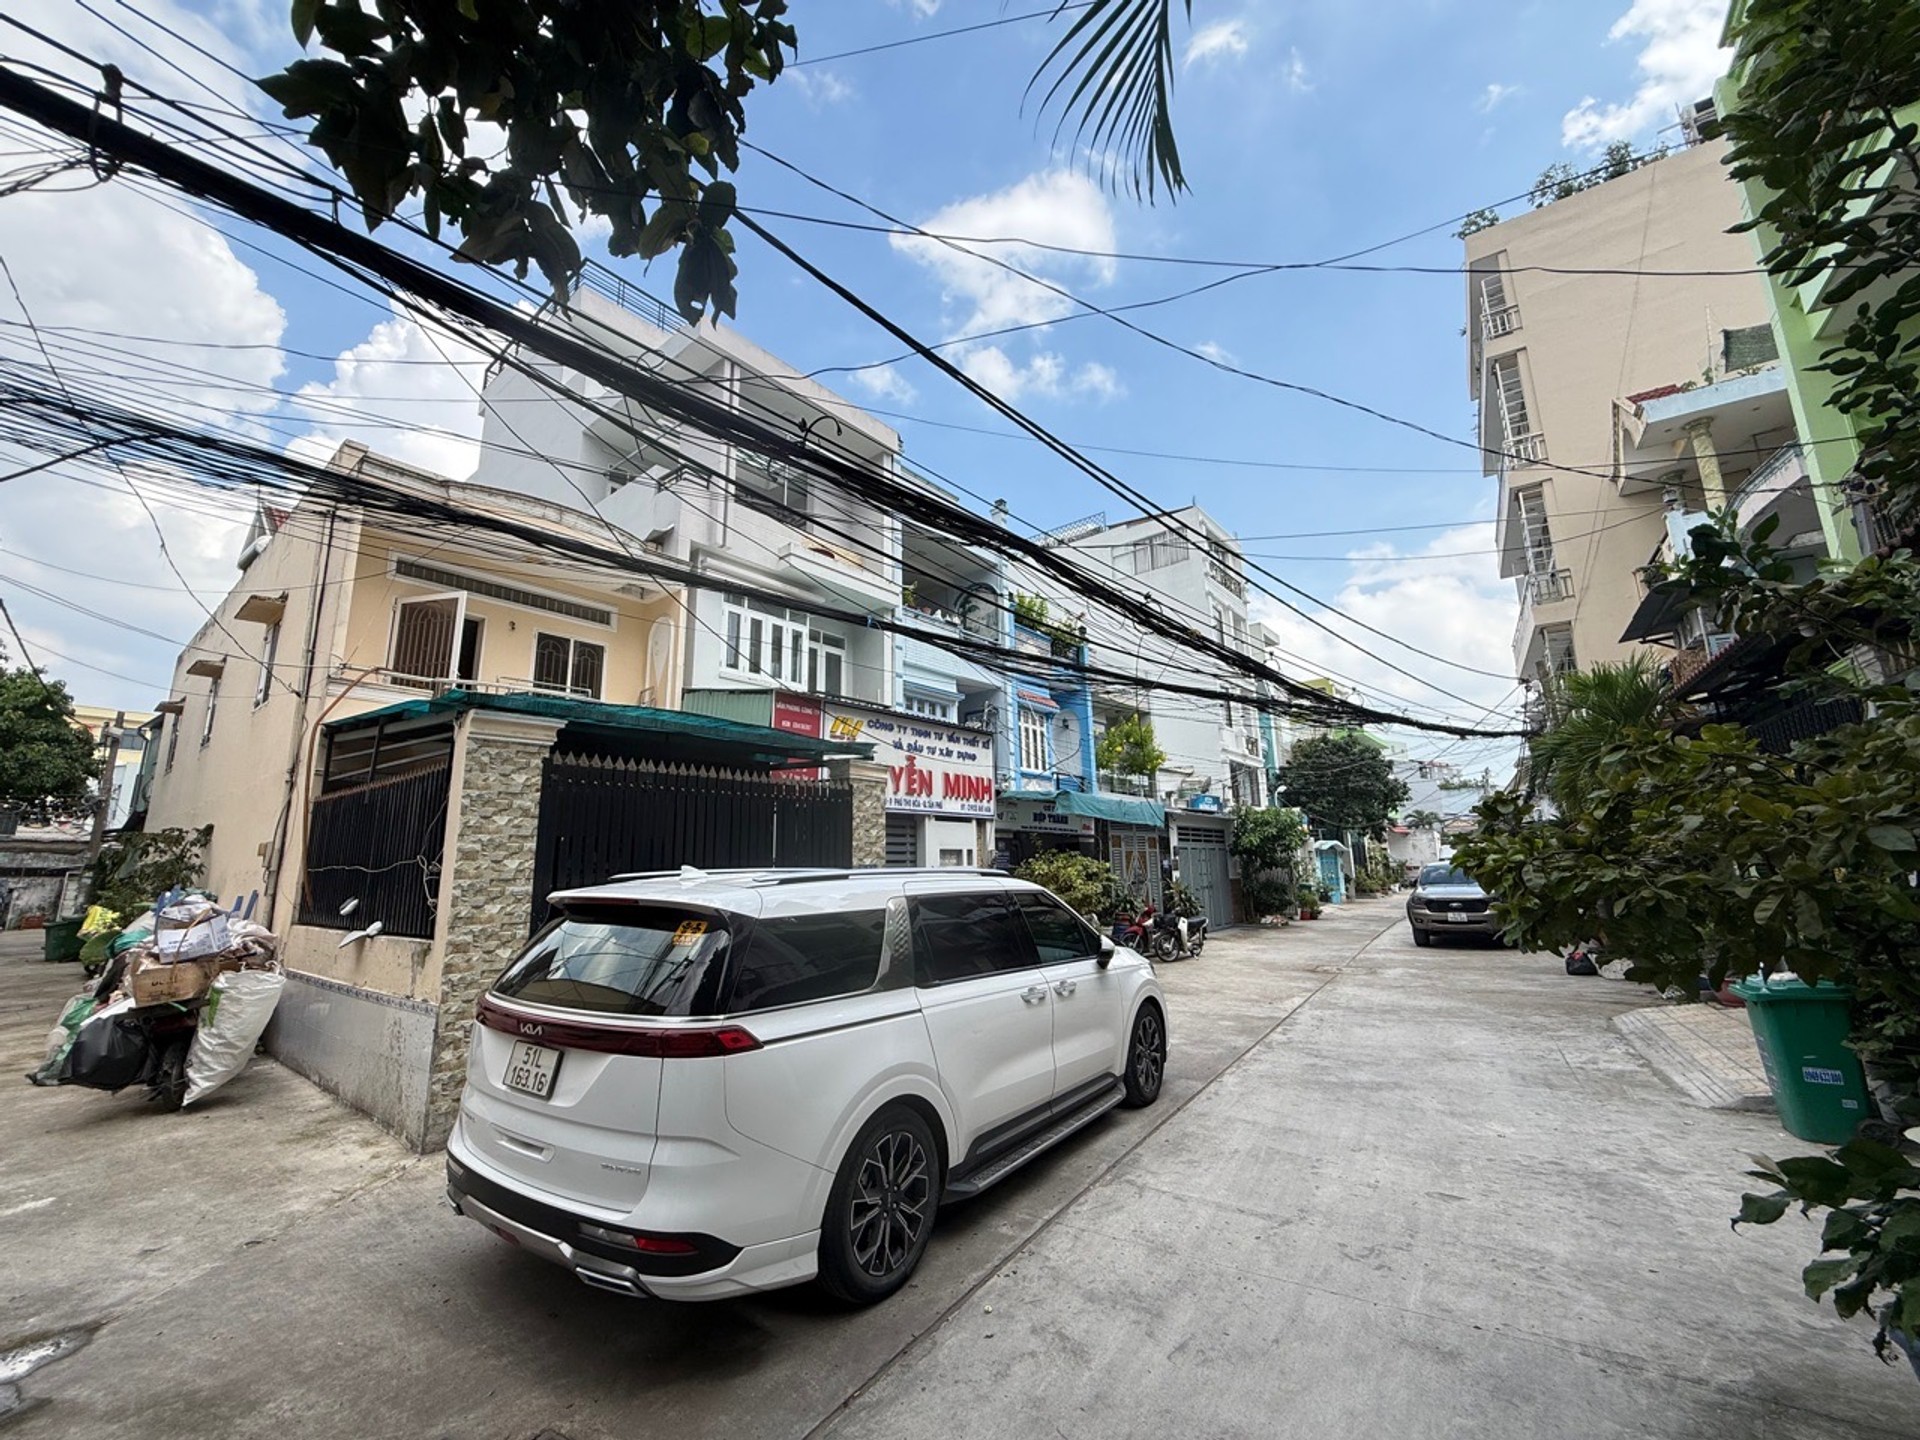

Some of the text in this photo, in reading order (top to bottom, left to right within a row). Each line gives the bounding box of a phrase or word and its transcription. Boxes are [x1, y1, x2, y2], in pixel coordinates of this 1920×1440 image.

[867, 719, 894, 732] CÔNG
[896, 724, 908, 735] TY
[956, 750, 978, 762] DỤNG
[888, 755, 993, 803] YỄN MINH
[522, 1046, 543, 1069] 51L
[510, 1065, 547, 1093] 163.16
